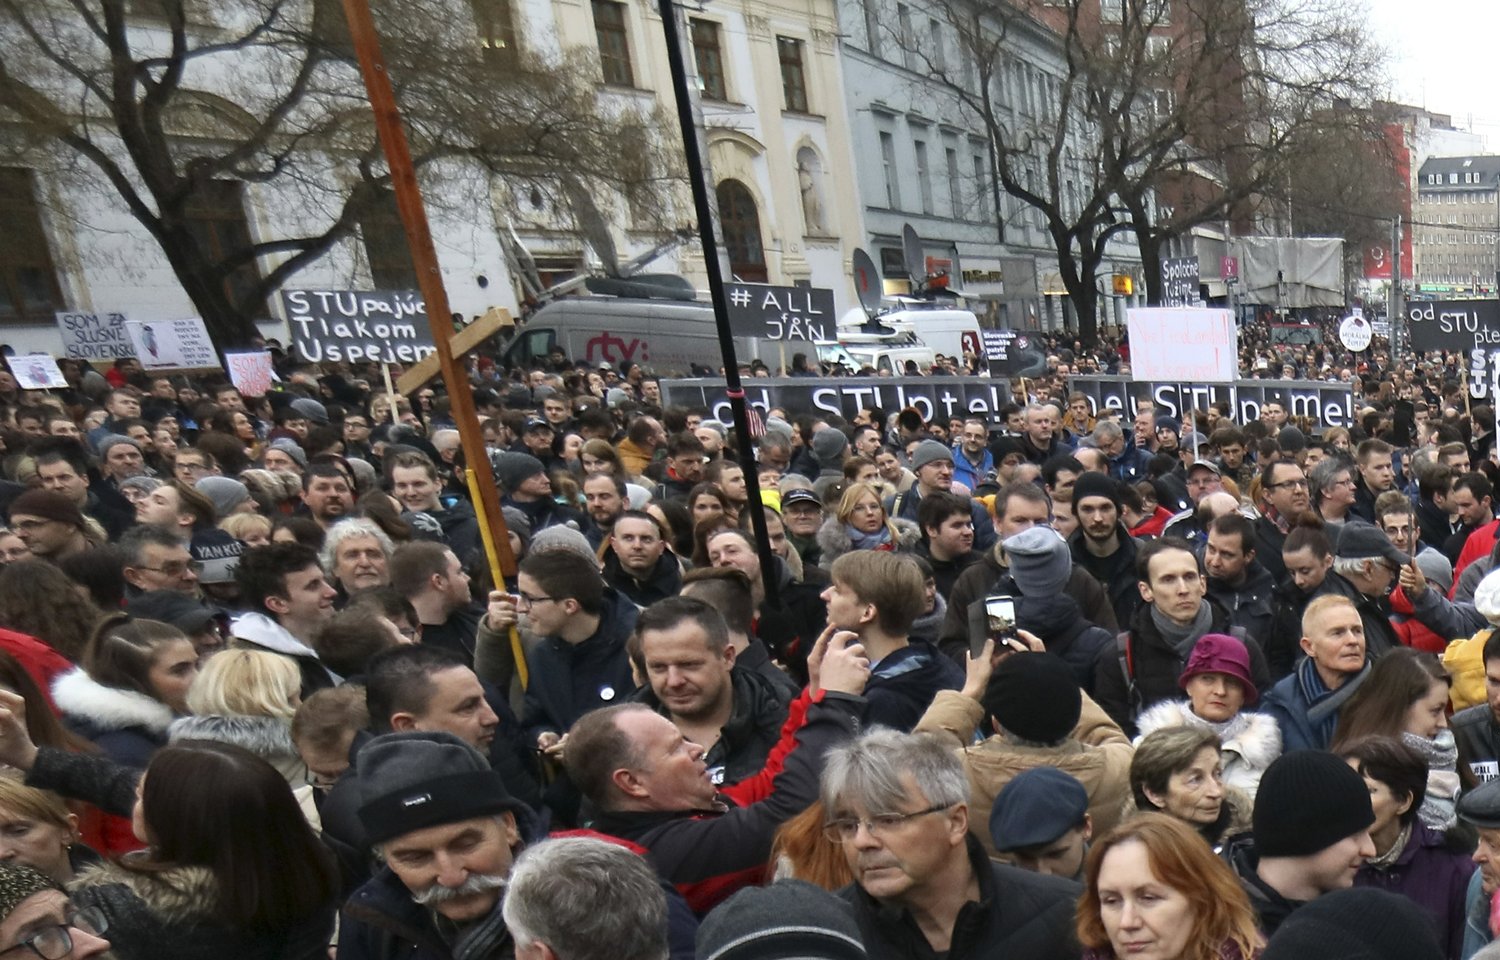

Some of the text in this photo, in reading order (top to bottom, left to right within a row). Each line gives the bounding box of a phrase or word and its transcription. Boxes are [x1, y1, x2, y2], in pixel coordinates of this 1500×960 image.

[1410, 303, 1435, 322] od
[63, 314, 99, 331] SOM
[292, 316, 417, 339] Tlakom
[962, 335, 975, 354] 3
